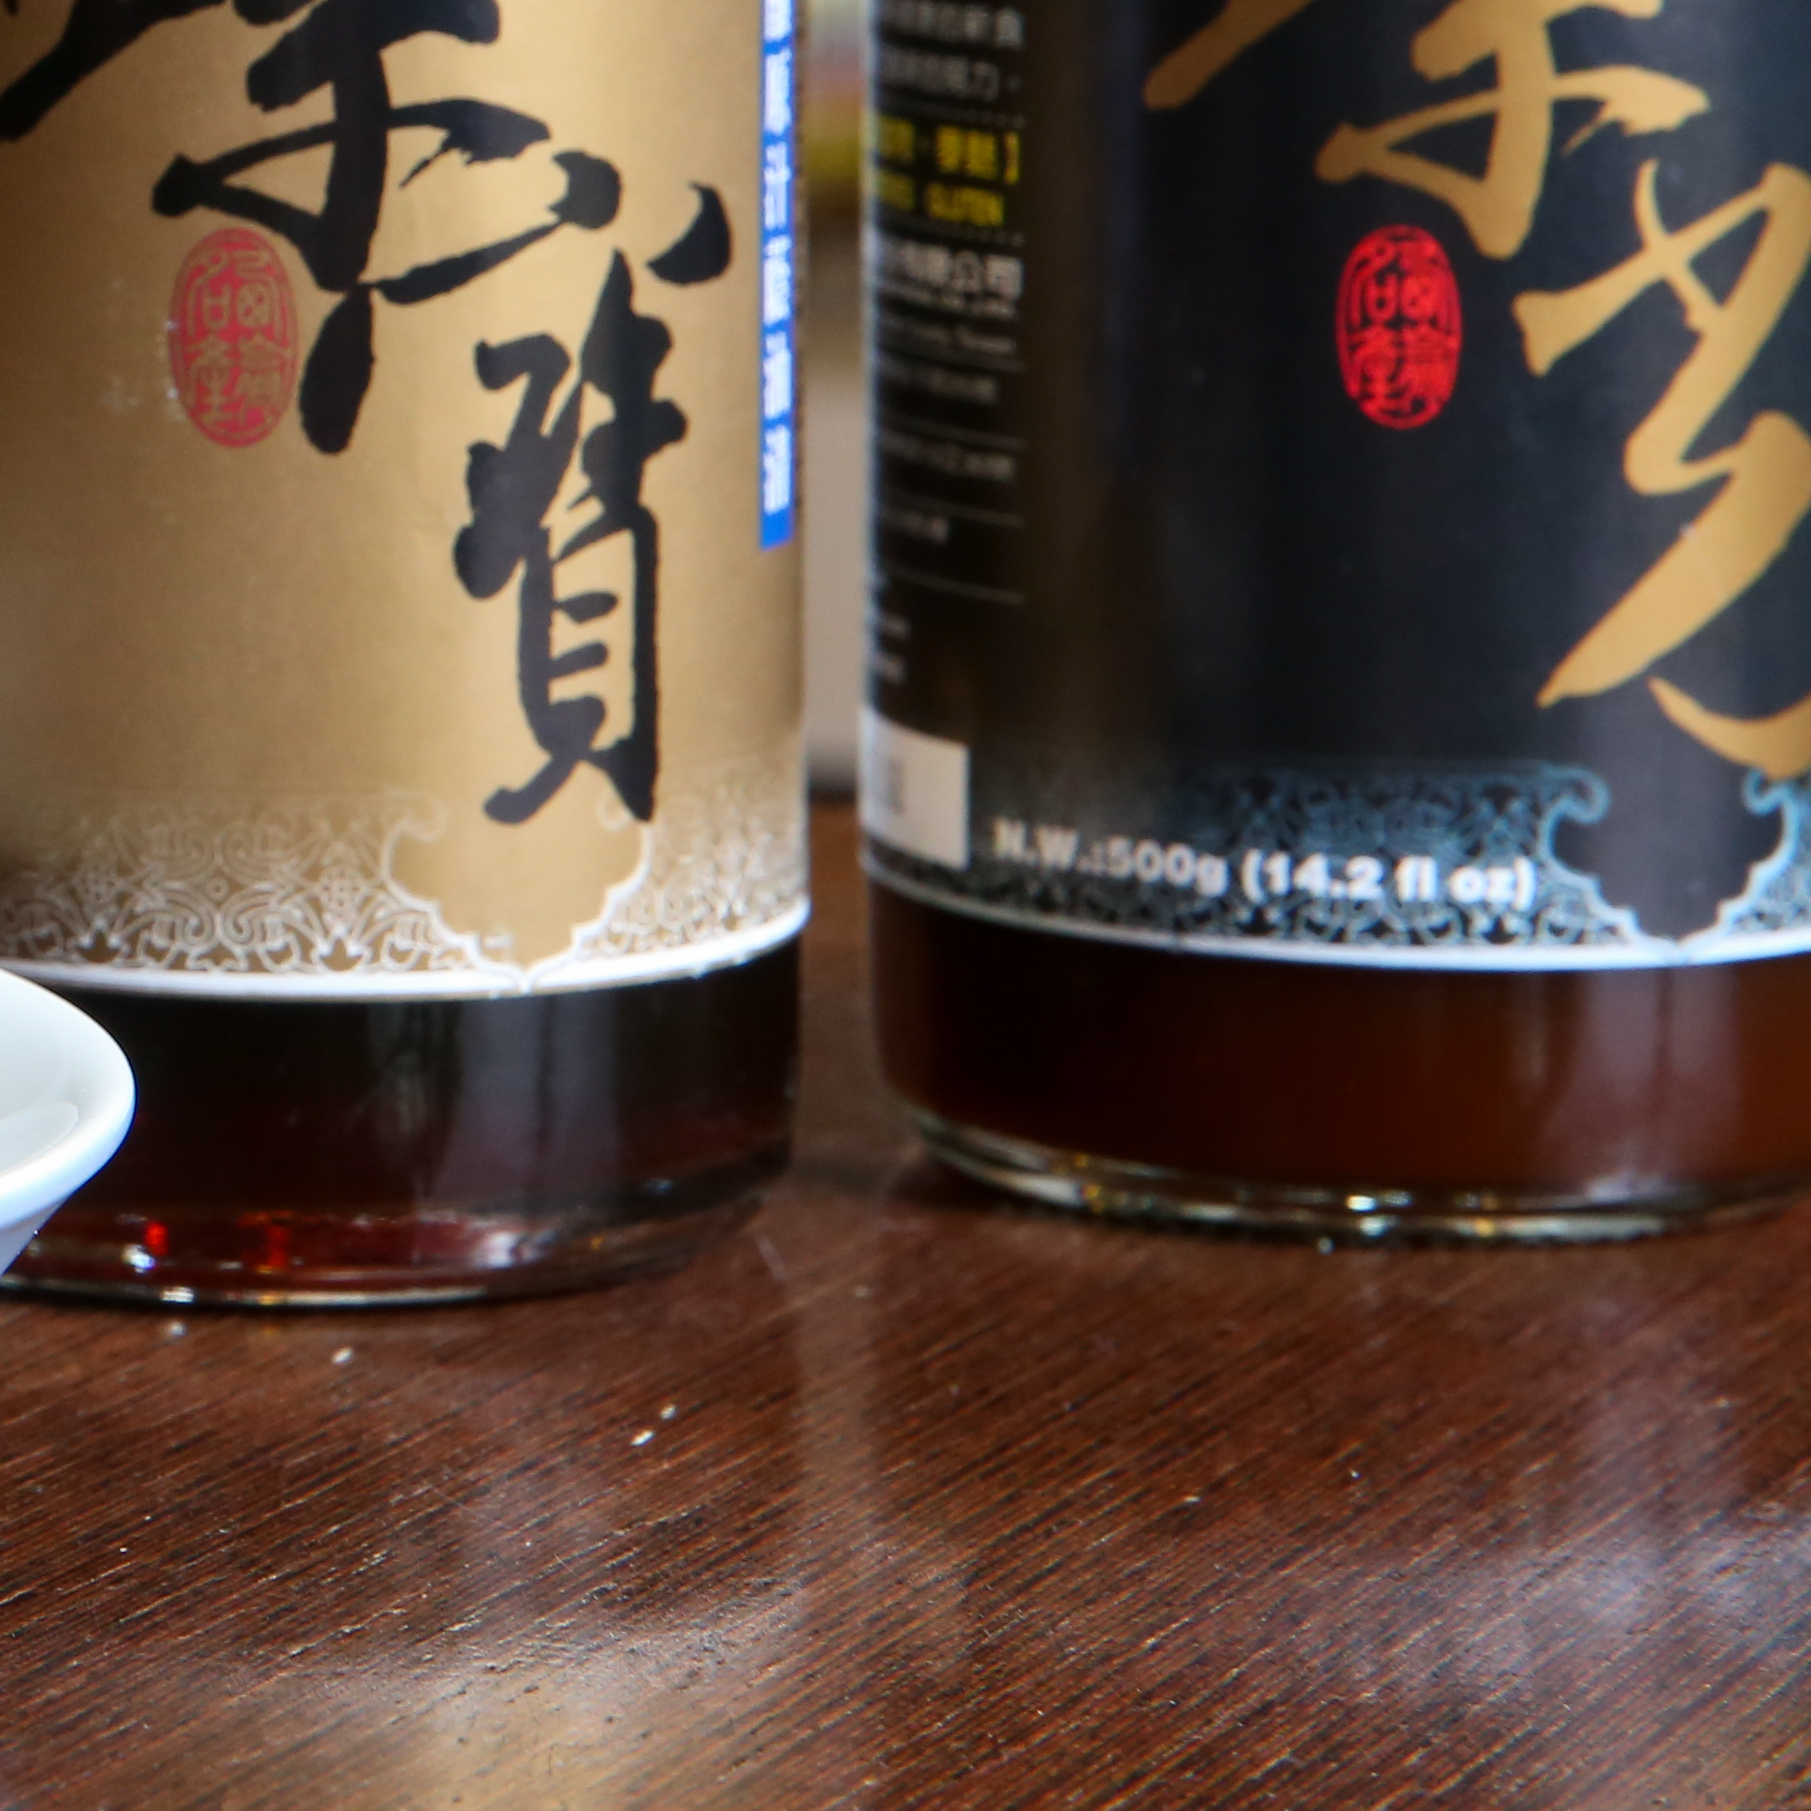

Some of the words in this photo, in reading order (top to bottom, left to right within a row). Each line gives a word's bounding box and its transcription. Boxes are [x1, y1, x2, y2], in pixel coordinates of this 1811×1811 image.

[1240, 848, 1383, 902] (14.2
[1395, 855, 1437, 902] fl
[1448, 854, 1537, 910] oz)
